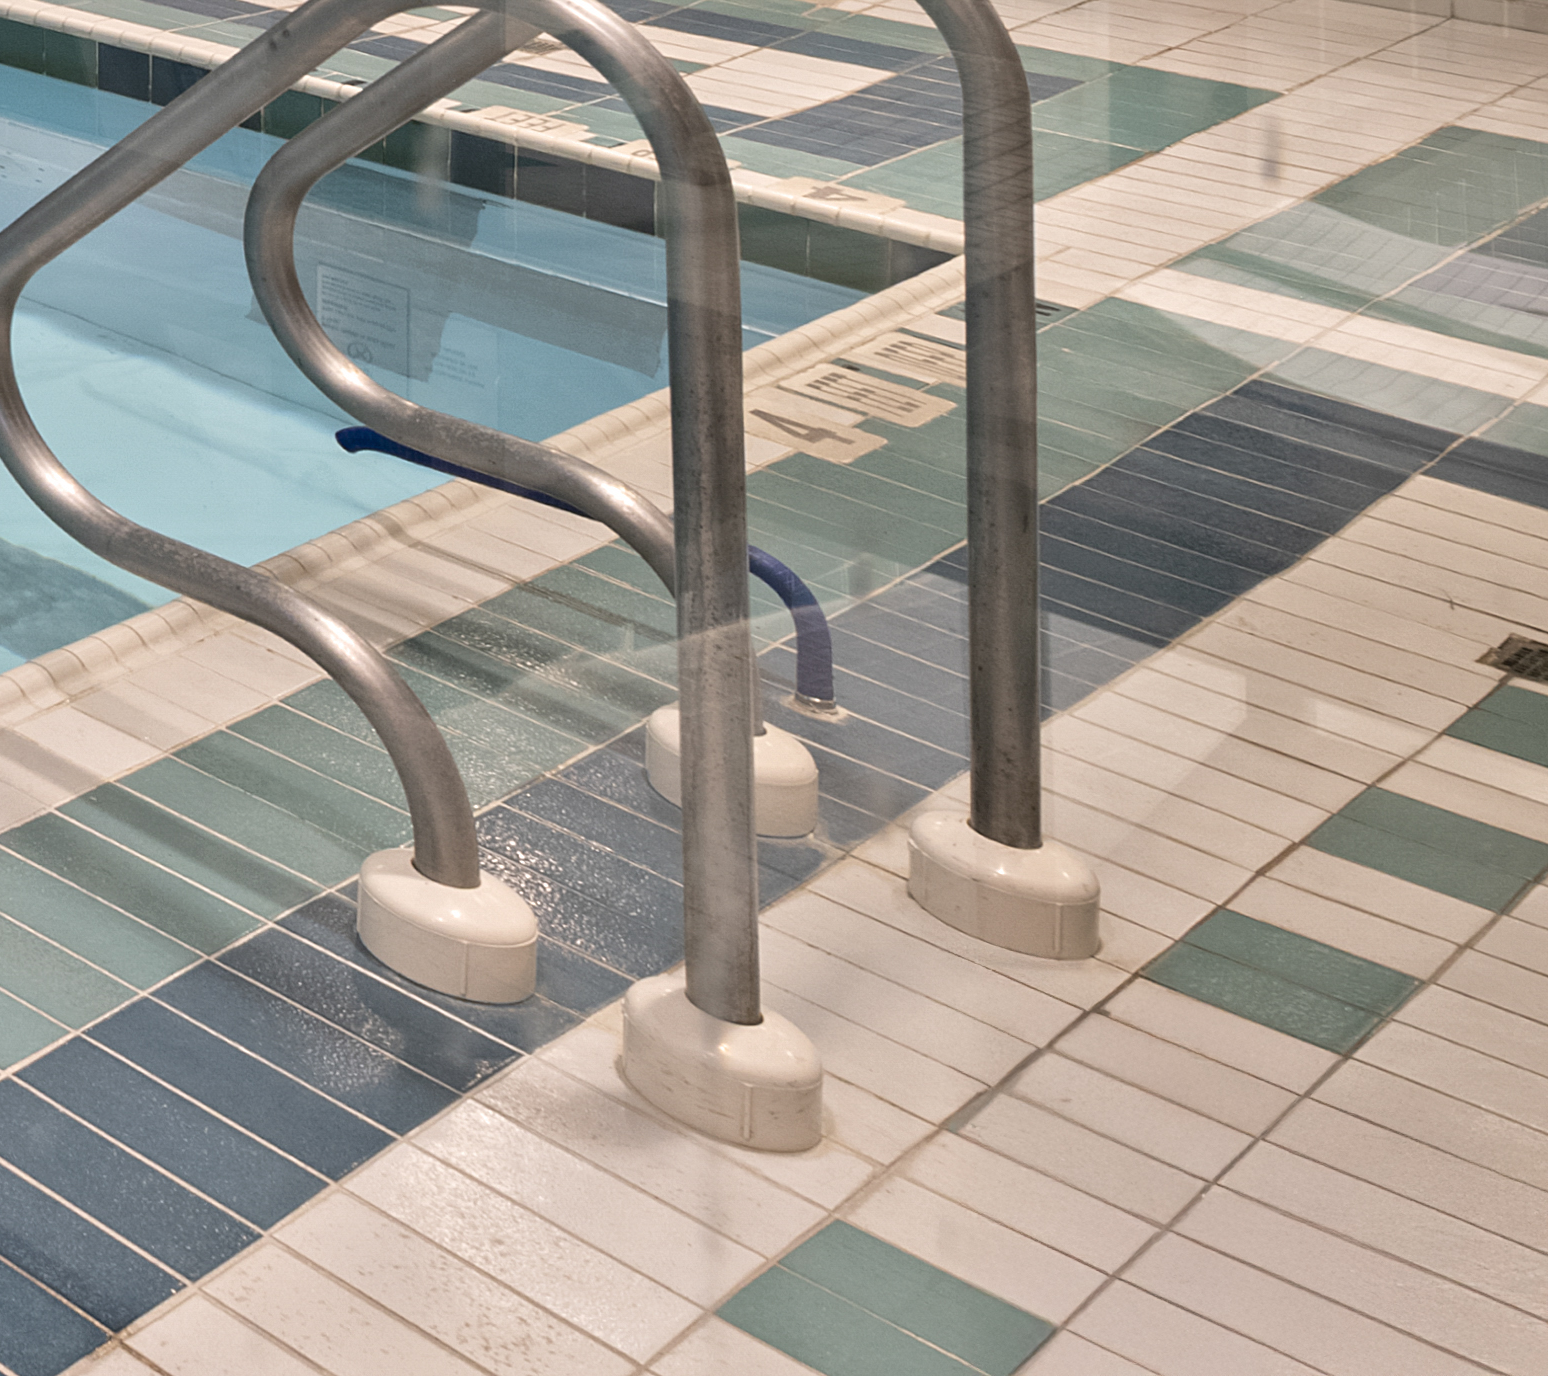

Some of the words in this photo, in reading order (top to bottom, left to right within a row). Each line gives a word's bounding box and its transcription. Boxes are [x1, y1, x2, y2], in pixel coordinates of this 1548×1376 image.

[485, 112, 566, 132] FEET
[802, 186, 868, 202] 4
[749, 408, 856, 446] 4
[806, 372, 927, 418] FEET
